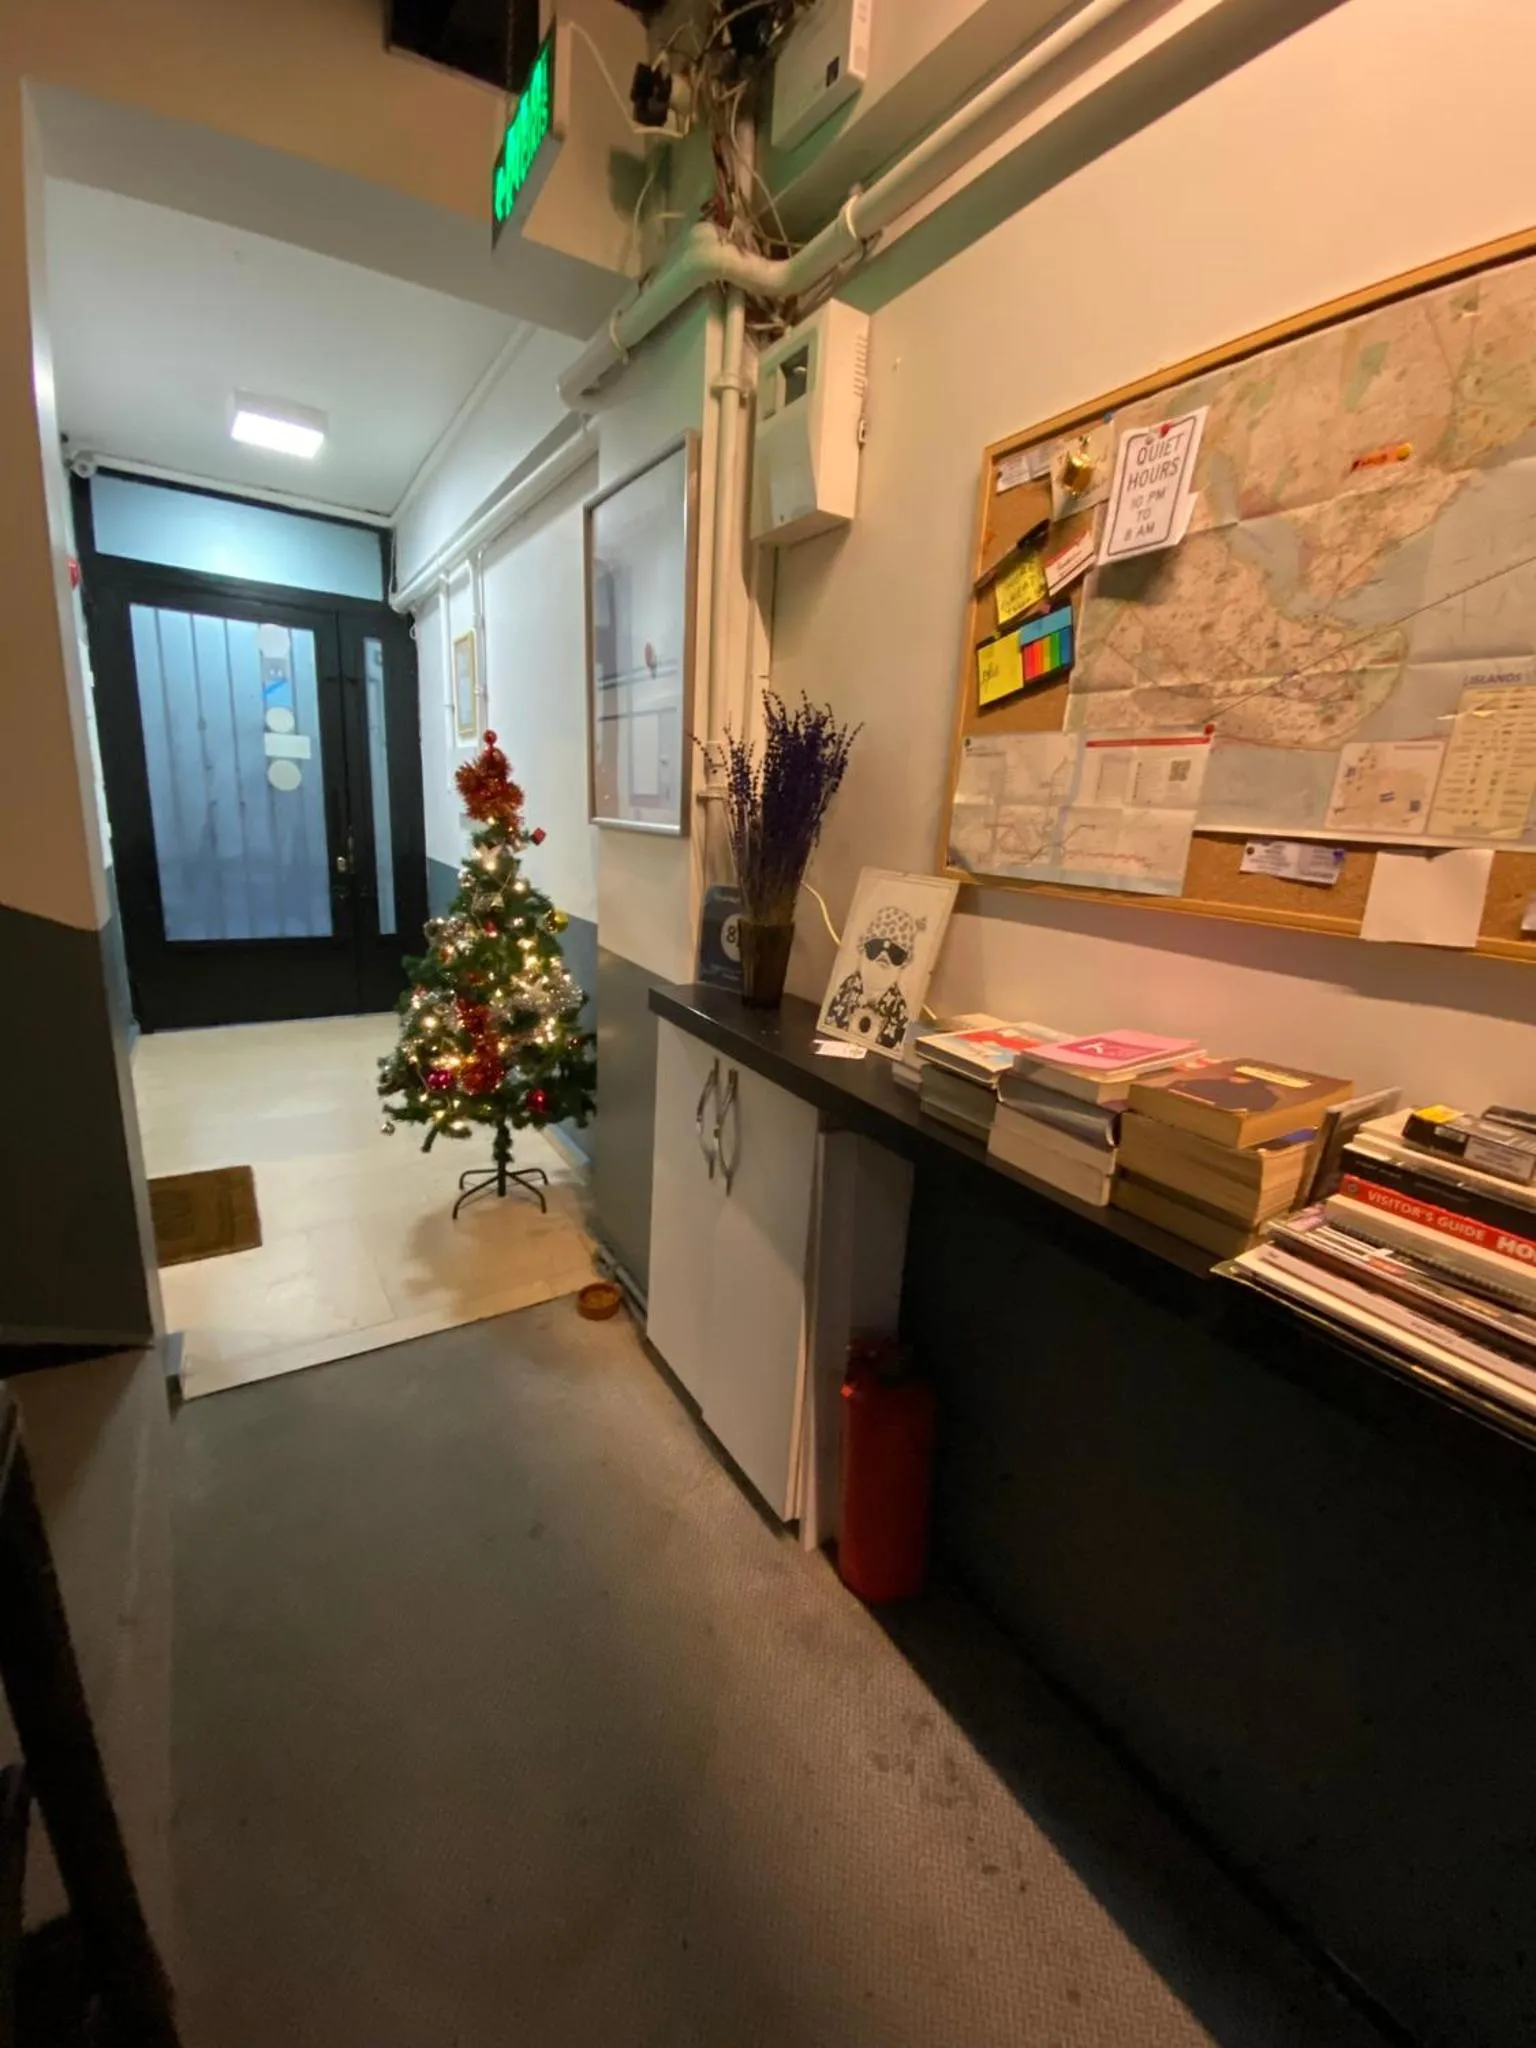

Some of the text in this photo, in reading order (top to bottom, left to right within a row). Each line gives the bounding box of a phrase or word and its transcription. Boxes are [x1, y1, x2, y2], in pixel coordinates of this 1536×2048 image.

[1136, 432, 1185, 466] QUIET
[1127, 457, 1181, 492] HOURS
[1130, 488, 1166, 509] 10 PM
[1136, 508, 1152, 522] TO
[1136, 522, 1156, 537] AM
[1367, 1189, 1435, 1223] VISITOR'S
[1436, 1215, 1488, 1242] GUIDE
[1495, 1234, 1536, 1263] HO
